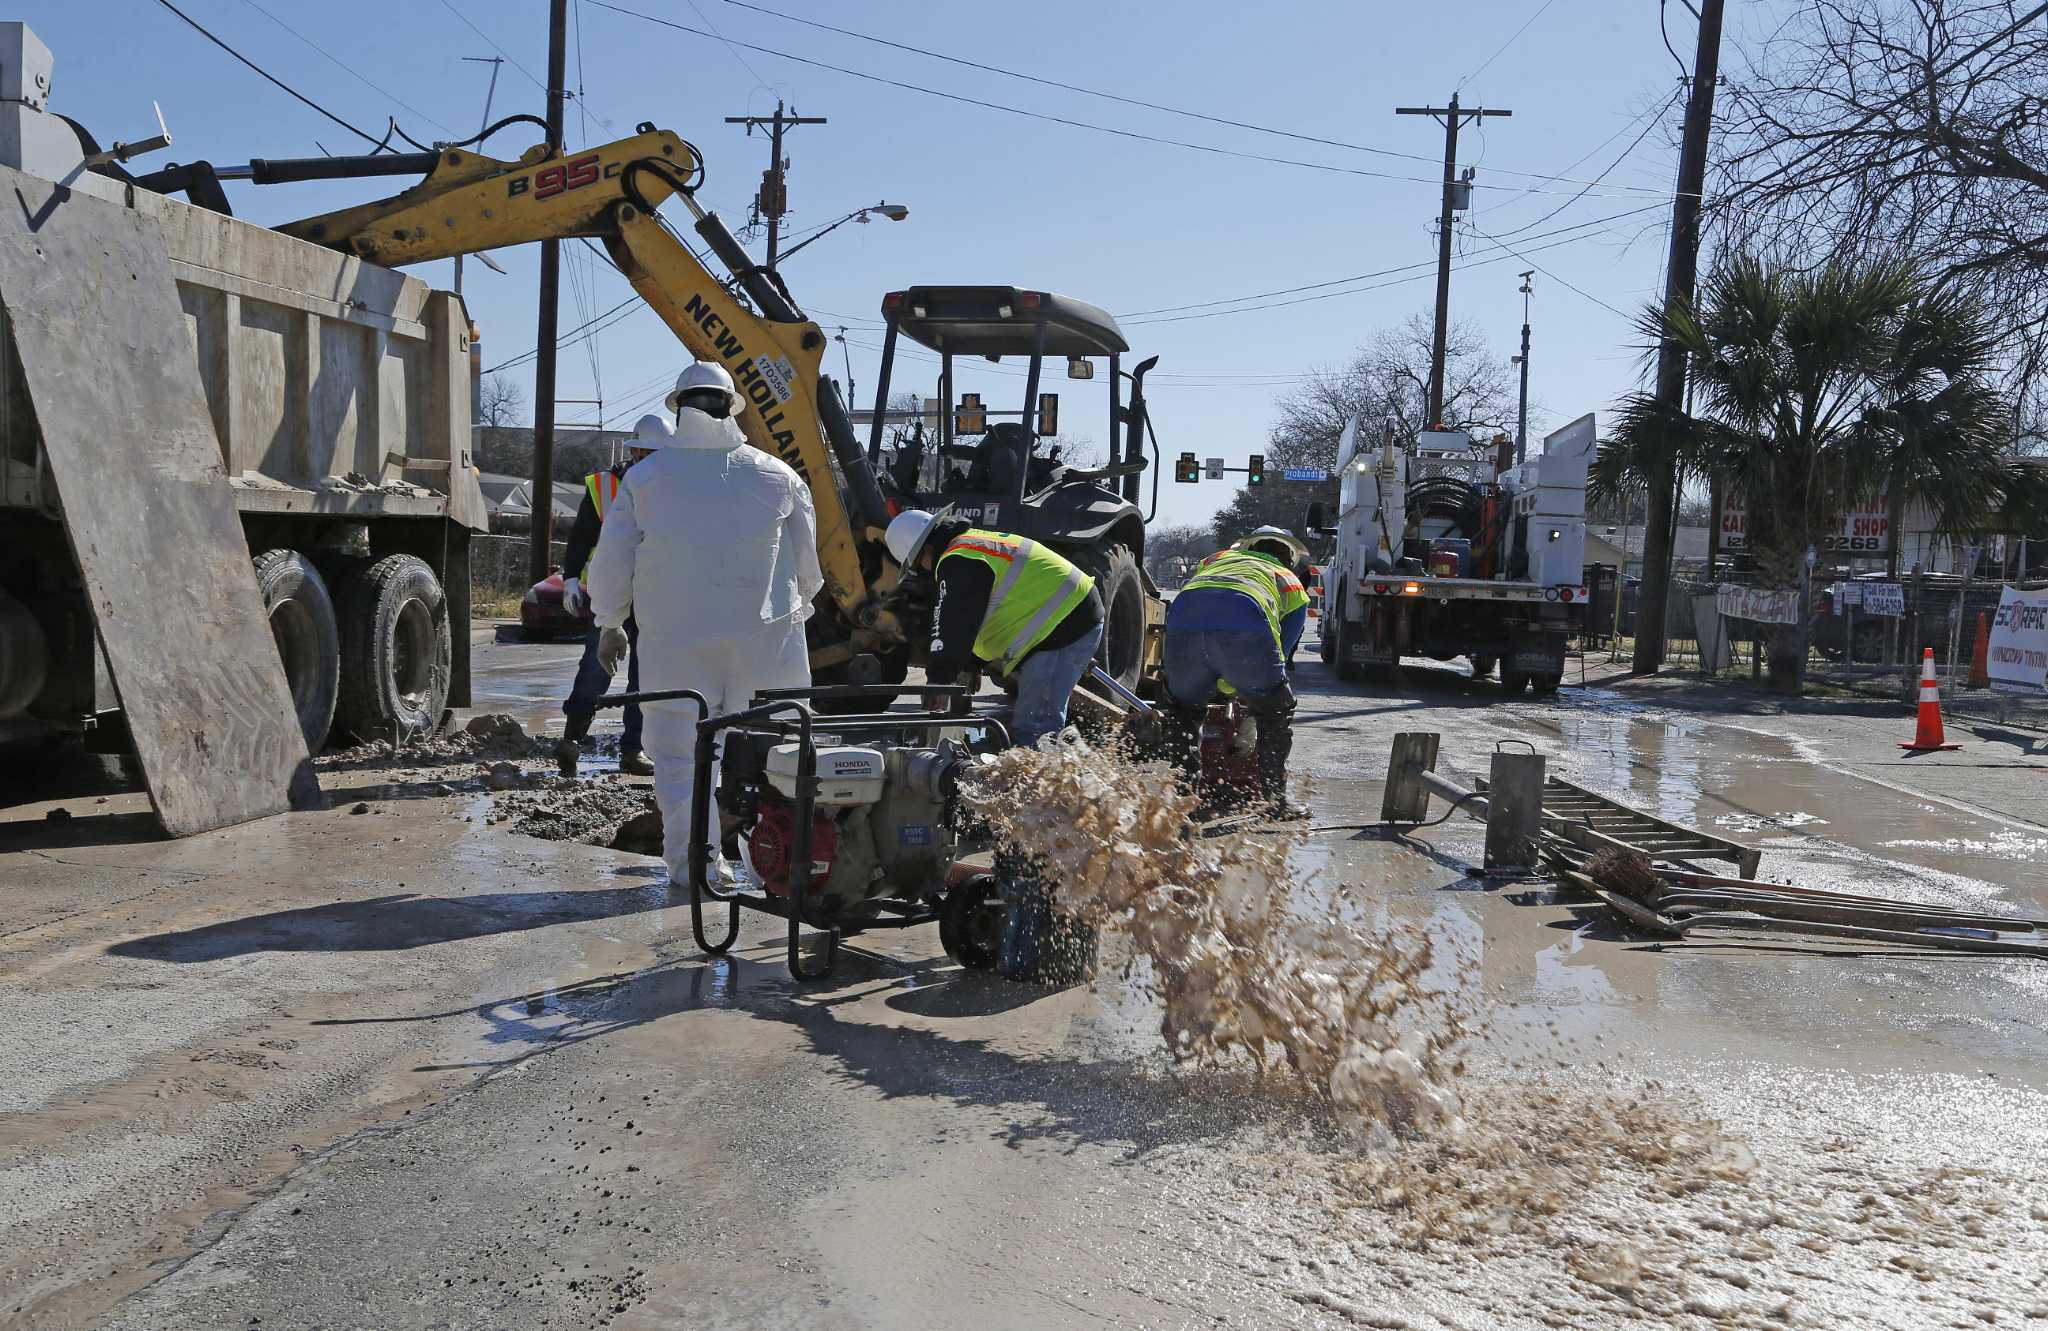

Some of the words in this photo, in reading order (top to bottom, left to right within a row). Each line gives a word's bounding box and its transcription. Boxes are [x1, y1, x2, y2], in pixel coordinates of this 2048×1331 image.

[684, 294, 745, 360] NEW
[759, 358, 791, 400] 1703586
[1853, 518, 1889, 537] SHOP
[1823, 536, 1880, 550] 2268
[834, 760, 870, 768] HONDA
